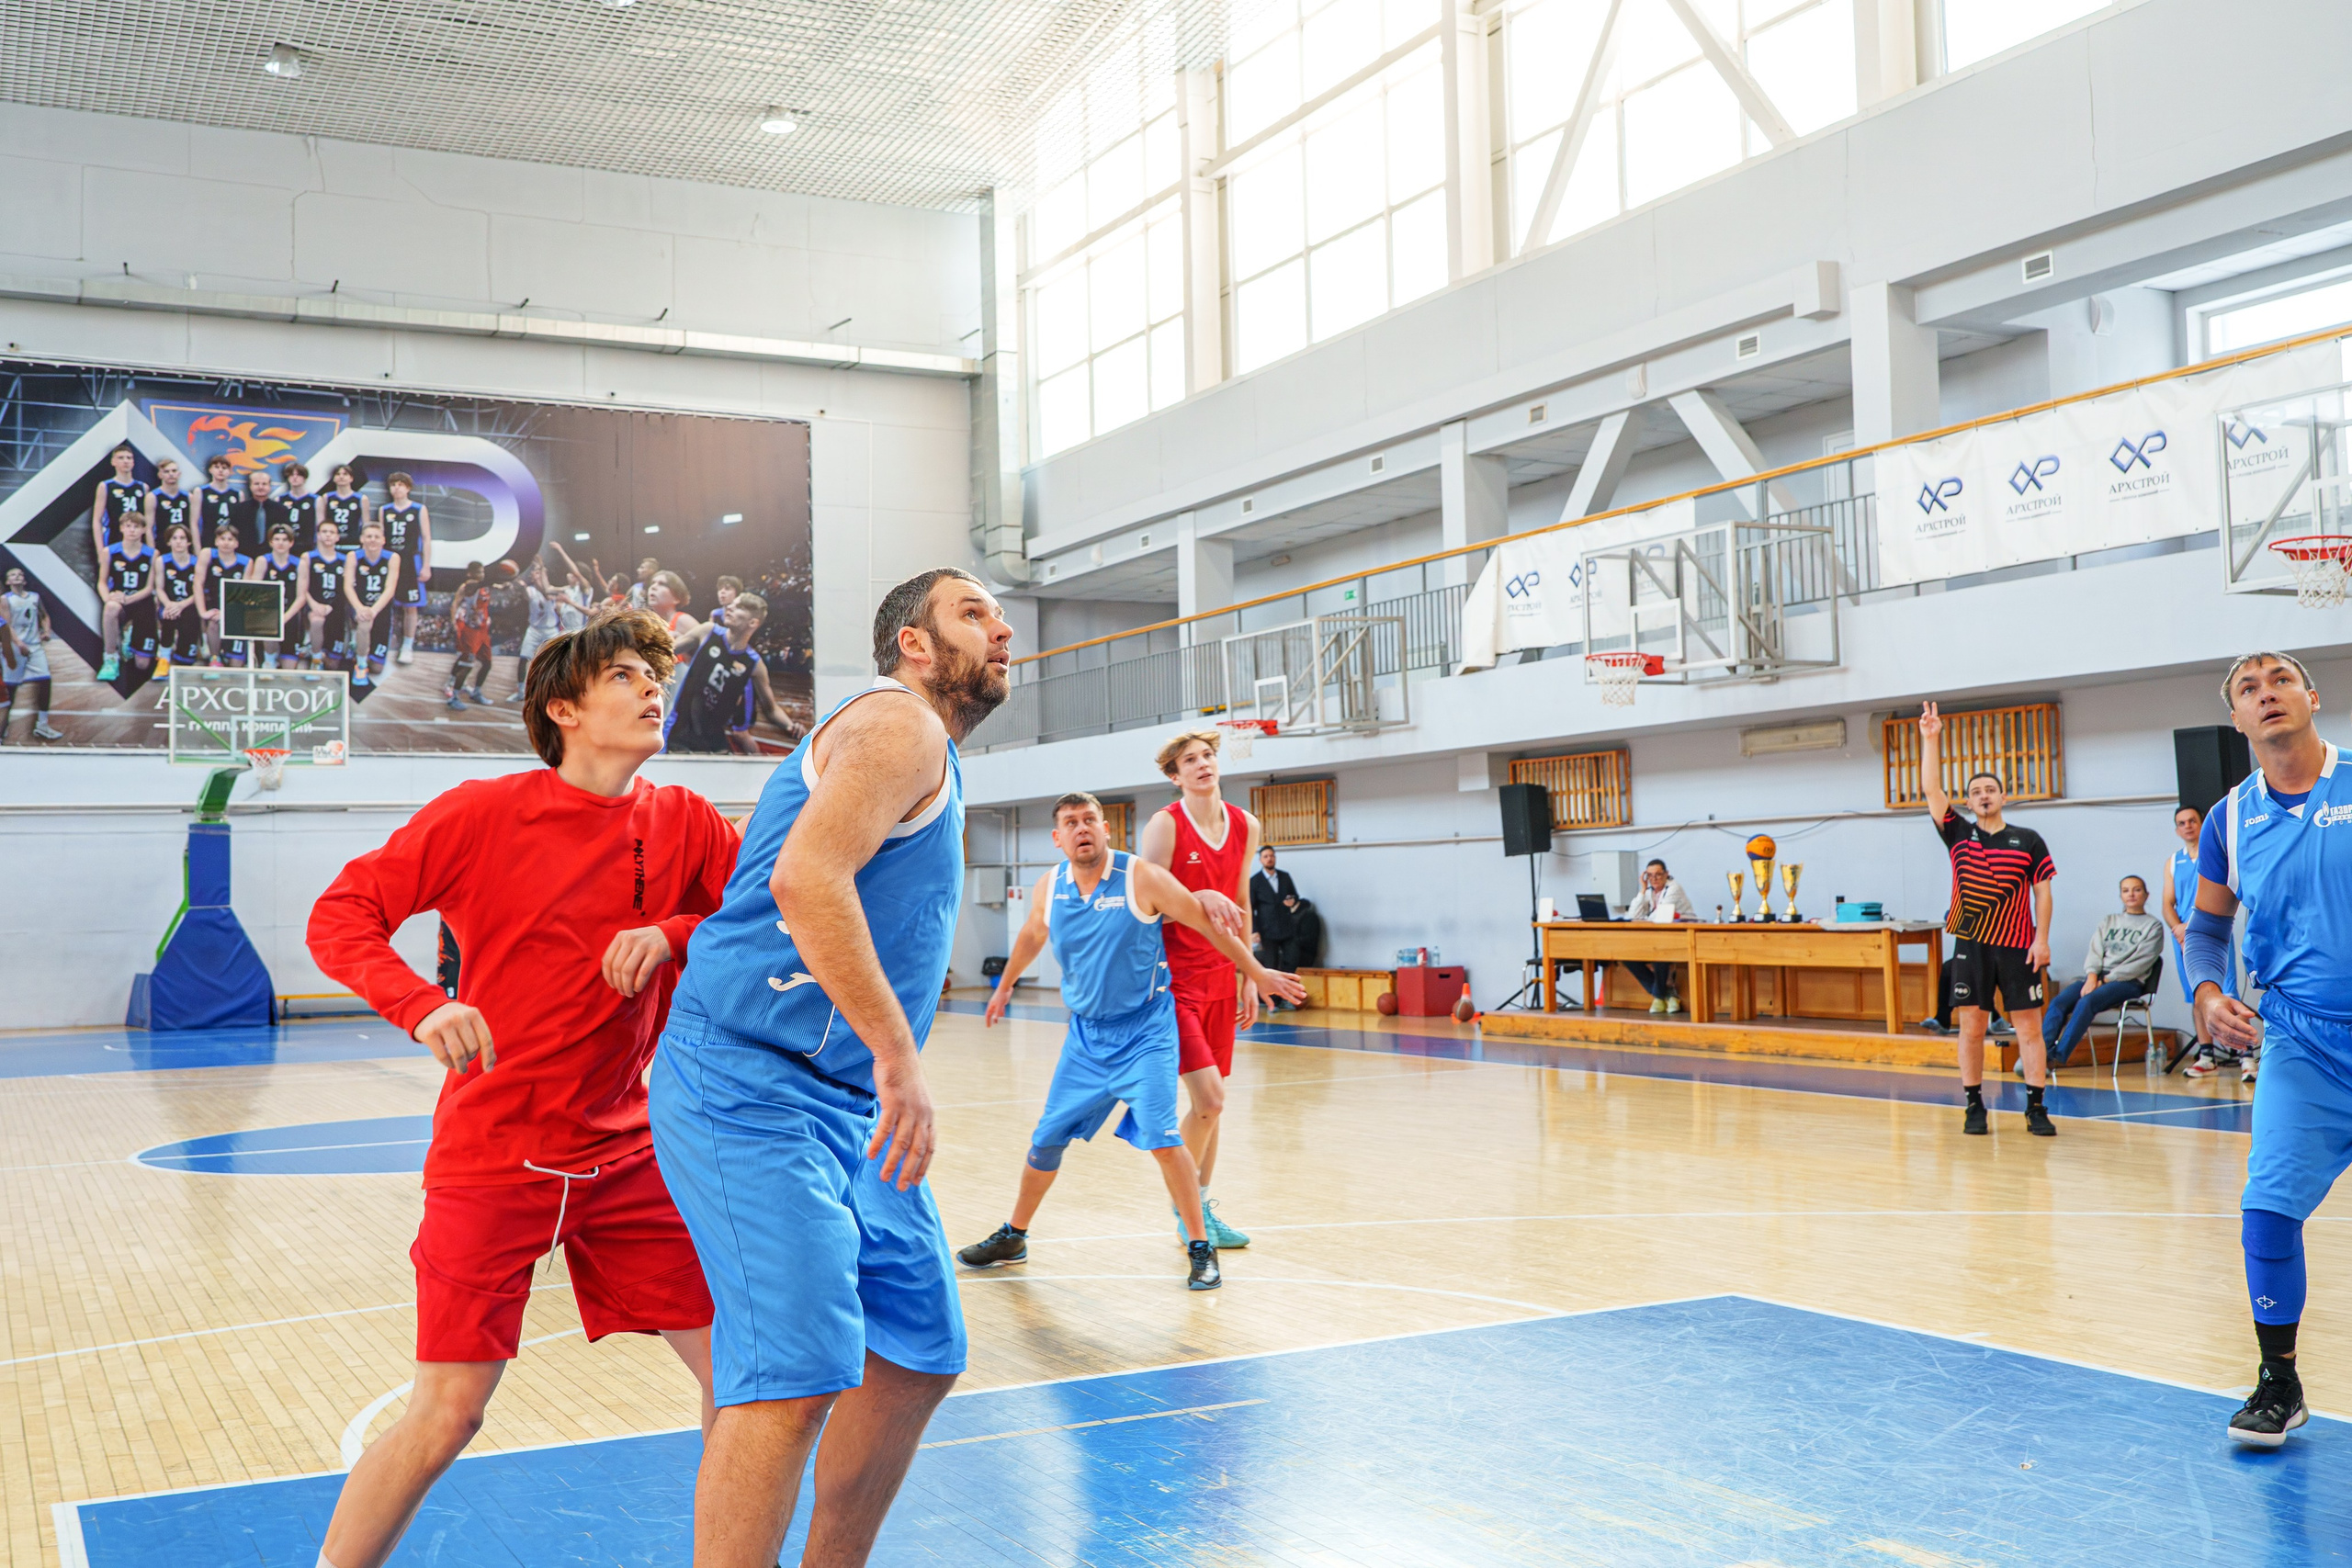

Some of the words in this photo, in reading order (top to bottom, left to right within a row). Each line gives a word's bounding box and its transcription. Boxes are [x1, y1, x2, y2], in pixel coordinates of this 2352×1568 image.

[2109, 471, 2170, 495] АРХСТРОЙ
[121, 496, 138, 512] 34
[219, 502, 230, 517] 4
[2006, 493, 2063, 516] АРХСТРОЙ
[170, 508, 183, 524] 23
[334, 508, 349, 524] 22
[1915, 513, 1967, 534] АРХСТРОЙ
[391, 521, 406, 536] 15
[123, 571, 139, 589] 13
[322, 572, 336, 590] 19
[366, 575, 381, 592] 12
[408, 589, 419, 602] 15
[154, 686, 336, 714] АРХСТРОЙ
[632, 838, 645, 910] POLYTHENE
[2105, 928, 2143, 945] NYC
[2029, 983, 2043, 1001] 16
